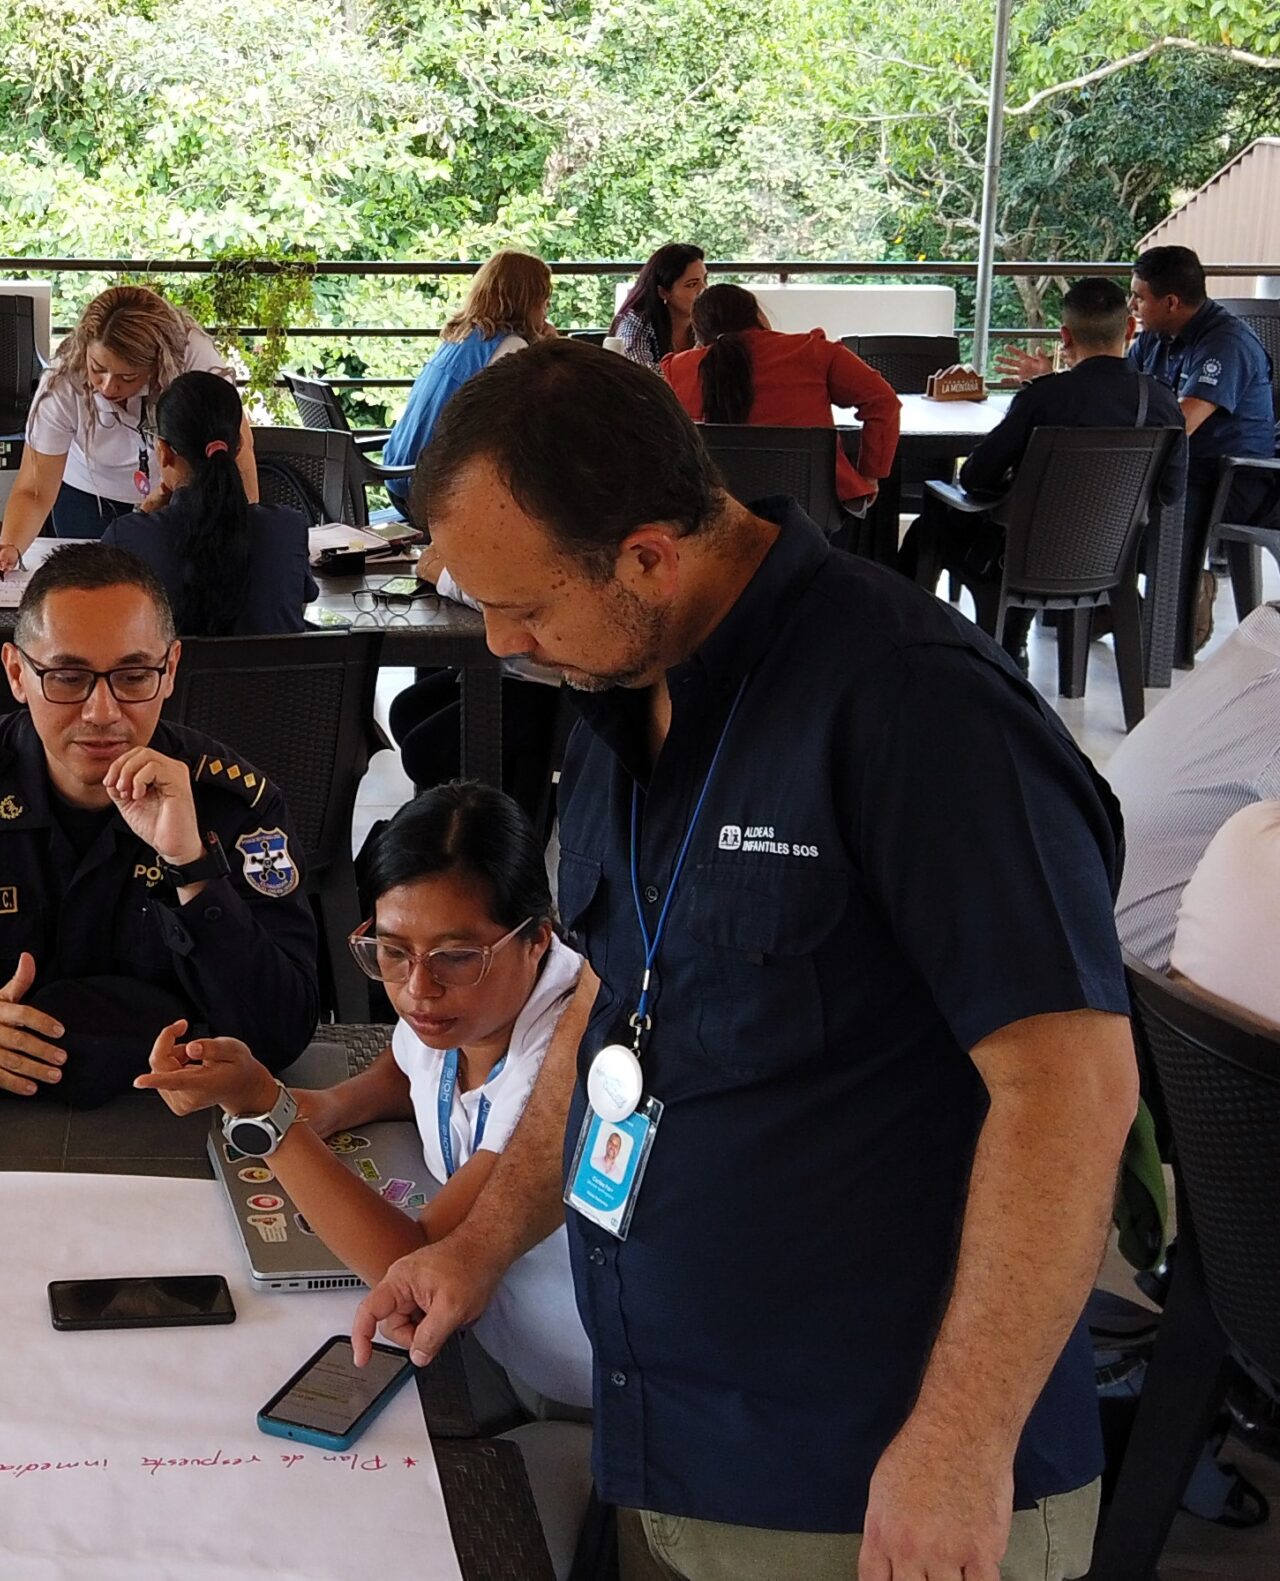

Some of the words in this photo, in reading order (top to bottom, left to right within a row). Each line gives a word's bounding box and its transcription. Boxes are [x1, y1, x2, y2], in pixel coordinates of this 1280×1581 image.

[744, 826, 774, 838] ALDEAS
[742, 840, 790, 855] INFANTILES
[793, 844, 819, 857] SOS
[2, 890, 13, 909] C.
[141, 1449, 261, 1475] respuesta
[280, 1454, 304, 1469] de
[322, 1453, 387, 1471] Plan
